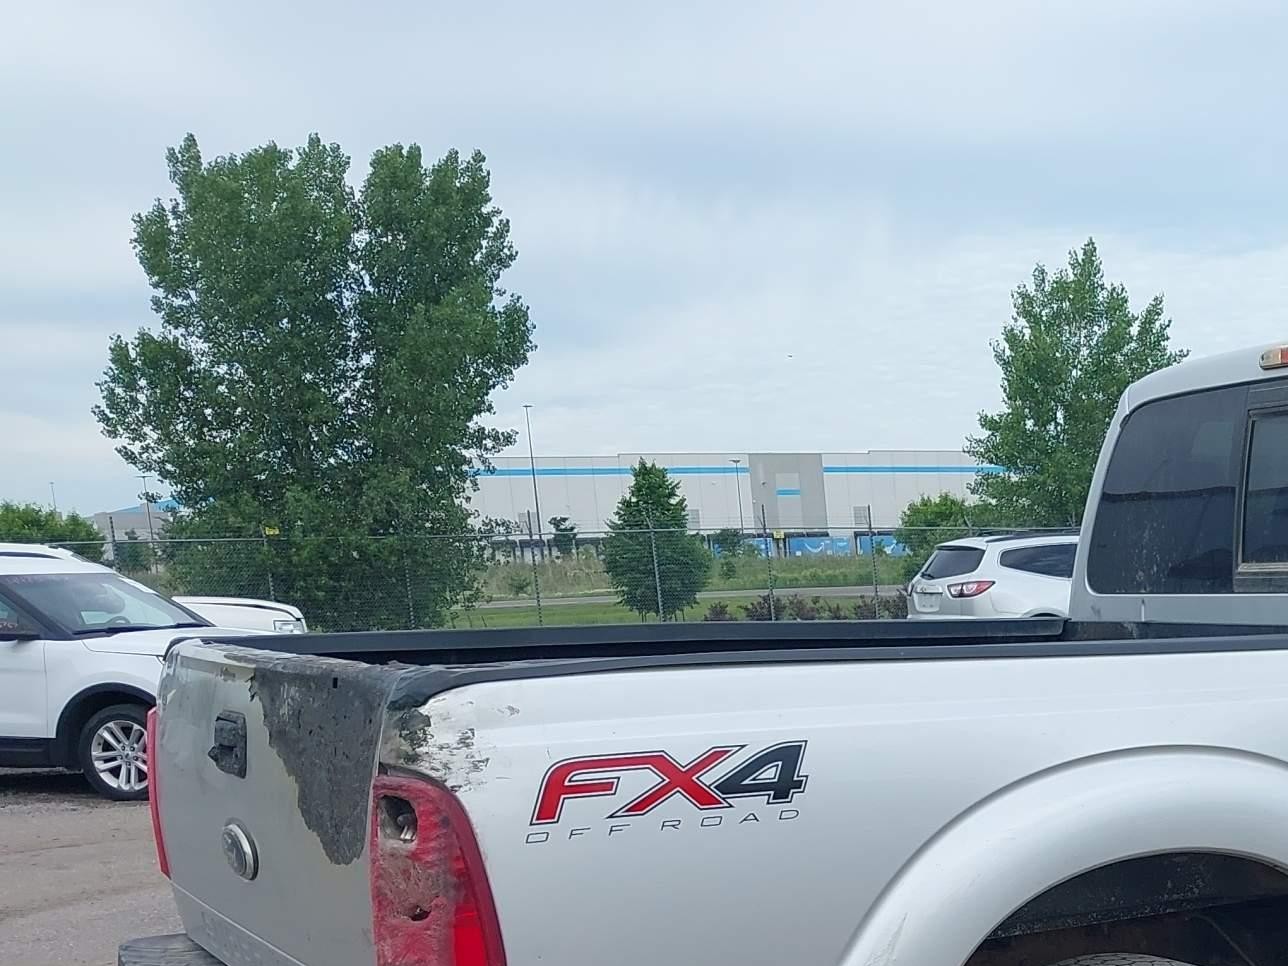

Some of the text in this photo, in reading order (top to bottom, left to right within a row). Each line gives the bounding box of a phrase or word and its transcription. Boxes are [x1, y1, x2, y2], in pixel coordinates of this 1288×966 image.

[530, 740, 809, 826] FX4
[525, 809, 800, 844] OFF ROAD
